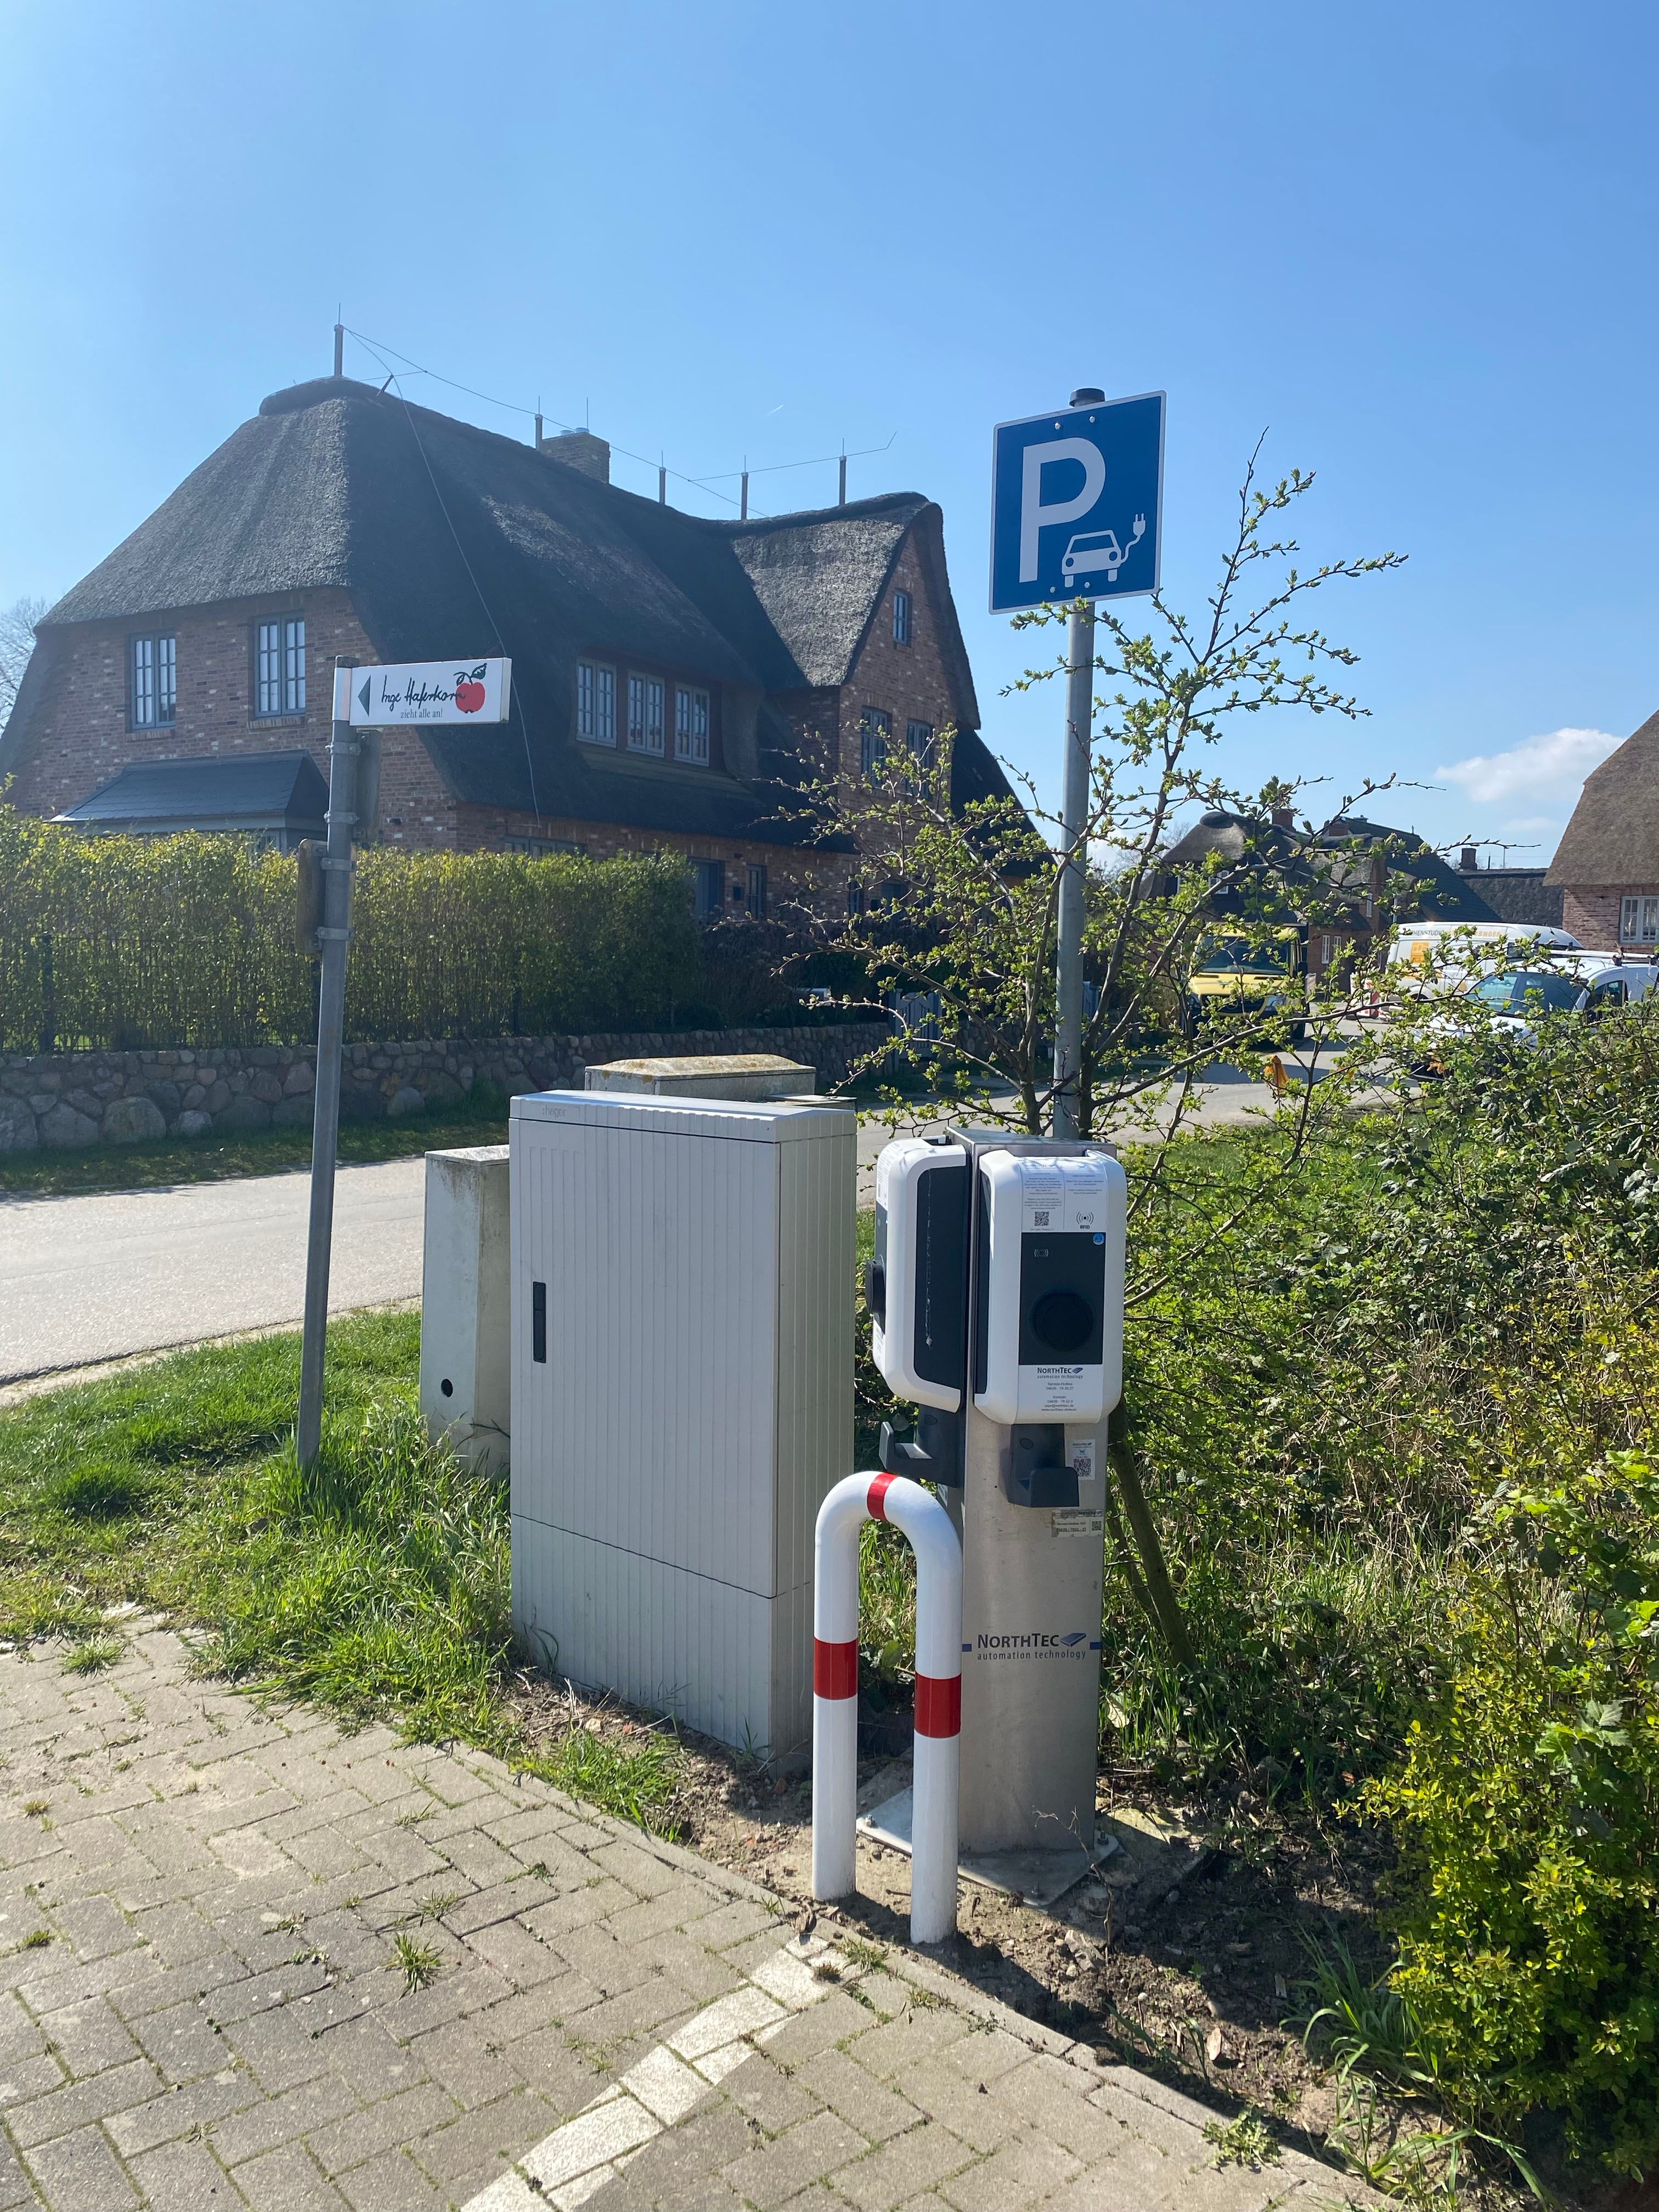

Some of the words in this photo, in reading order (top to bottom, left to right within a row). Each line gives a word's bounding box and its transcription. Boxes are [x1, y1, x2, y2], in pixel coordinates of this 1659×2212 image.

[1019, 437, 1106, 583] P
[381, 674, 401, 712] Inge
[404, 677, 466, 709] Haferkorn
[419, 709, 431, 718] alle
[432, 708, 443, 718] an!
[978, 1651, 1031, 1660] automation
[1035, 1650, 1086, 1660] technology
